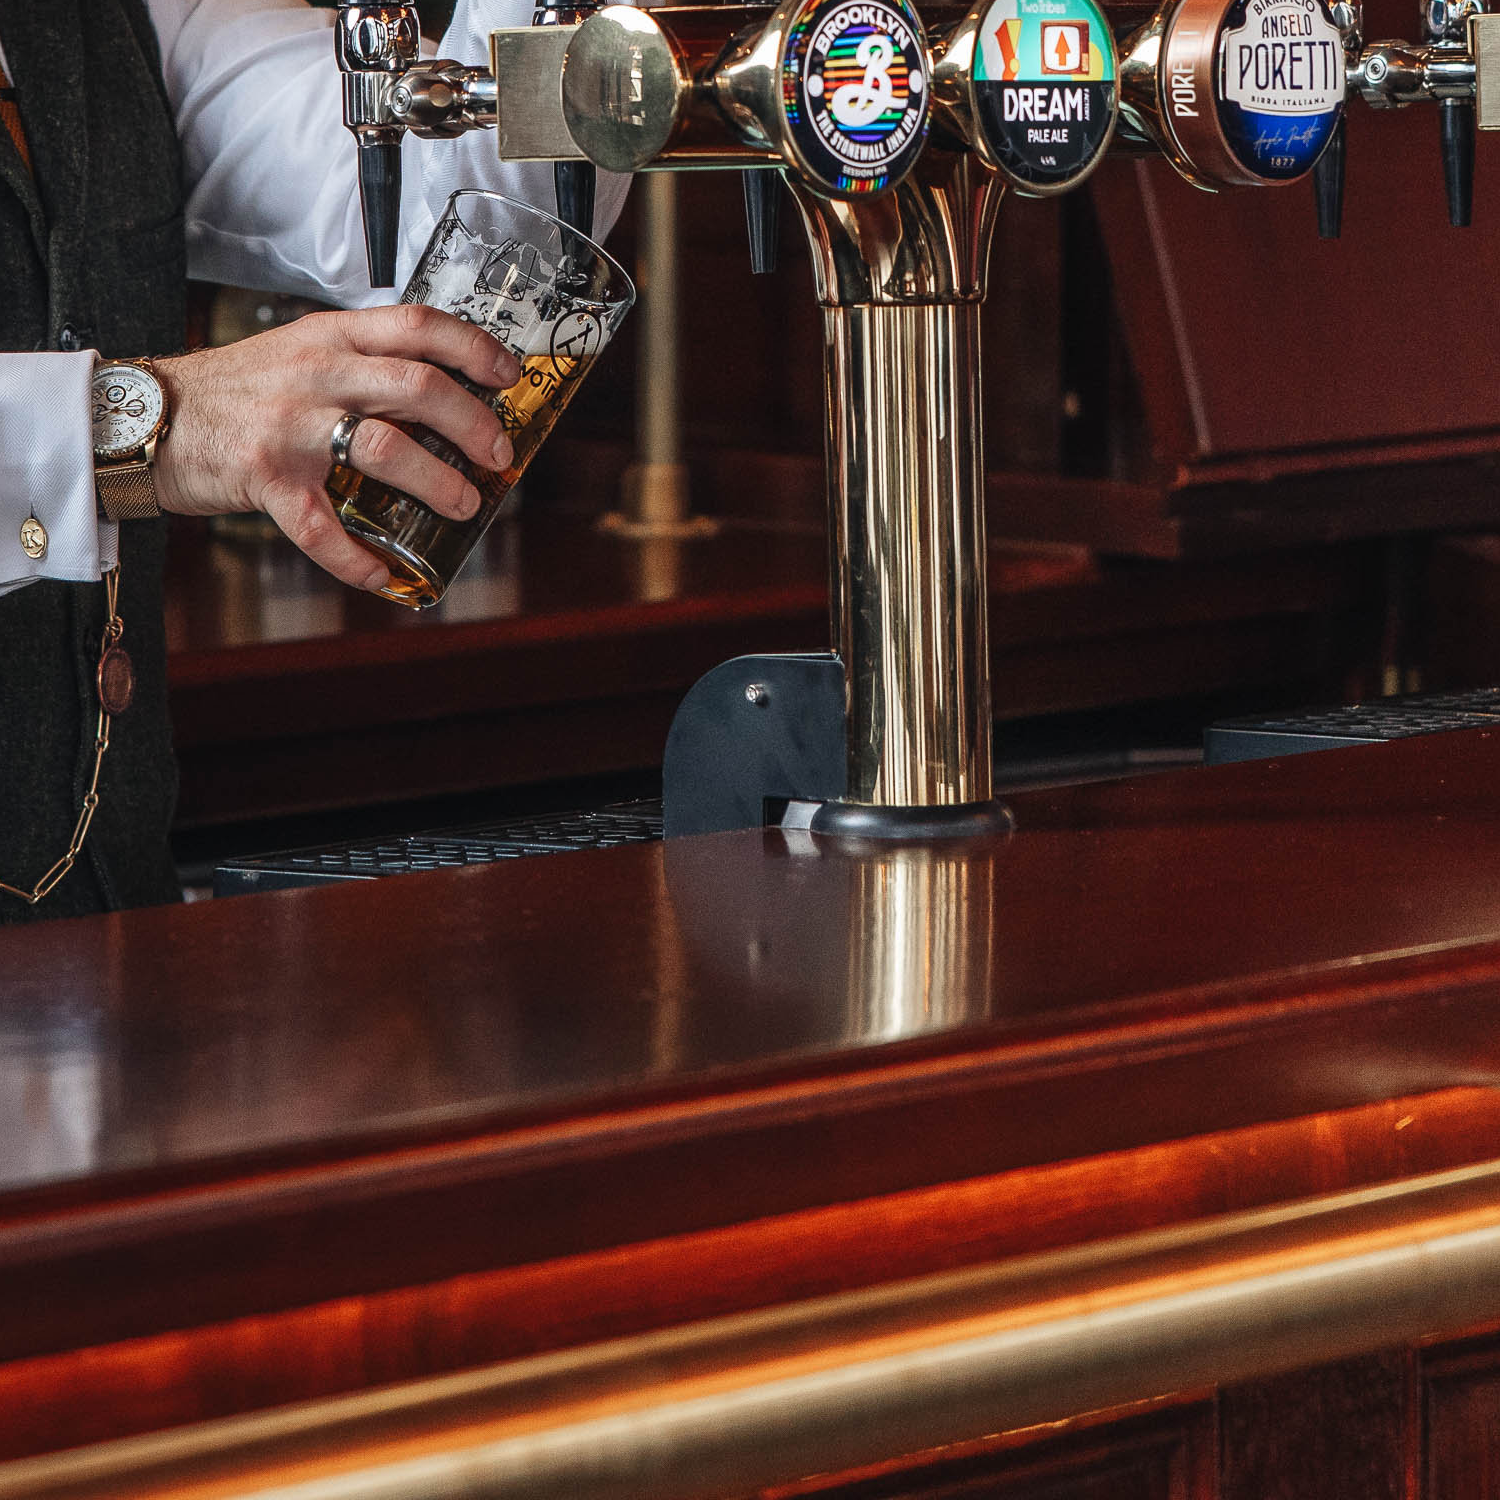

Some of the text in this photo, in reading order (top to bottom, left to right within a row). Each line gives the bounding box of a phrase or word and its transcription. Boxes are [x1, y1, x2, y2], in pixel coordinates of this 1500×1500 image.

[814, 6, 912, 56] BROOKLYN
[1261, 13, 1313, 38] ANGELO
[1171, 30, 1200, 117] POREI
[1239, 40, 1338, 91] PORETTI
[1003, 87, 1084, 122] DREAM
[1251, 95, 1326, 107] BIRRA ITALIANA
[815, 107, 919, 161] THE STONEWALL INN IPA
[1027, 128, 1070, 143] PALE ALE
[1270, 156, 1297, 167] 1877
[22, 527, 43, 548] K
